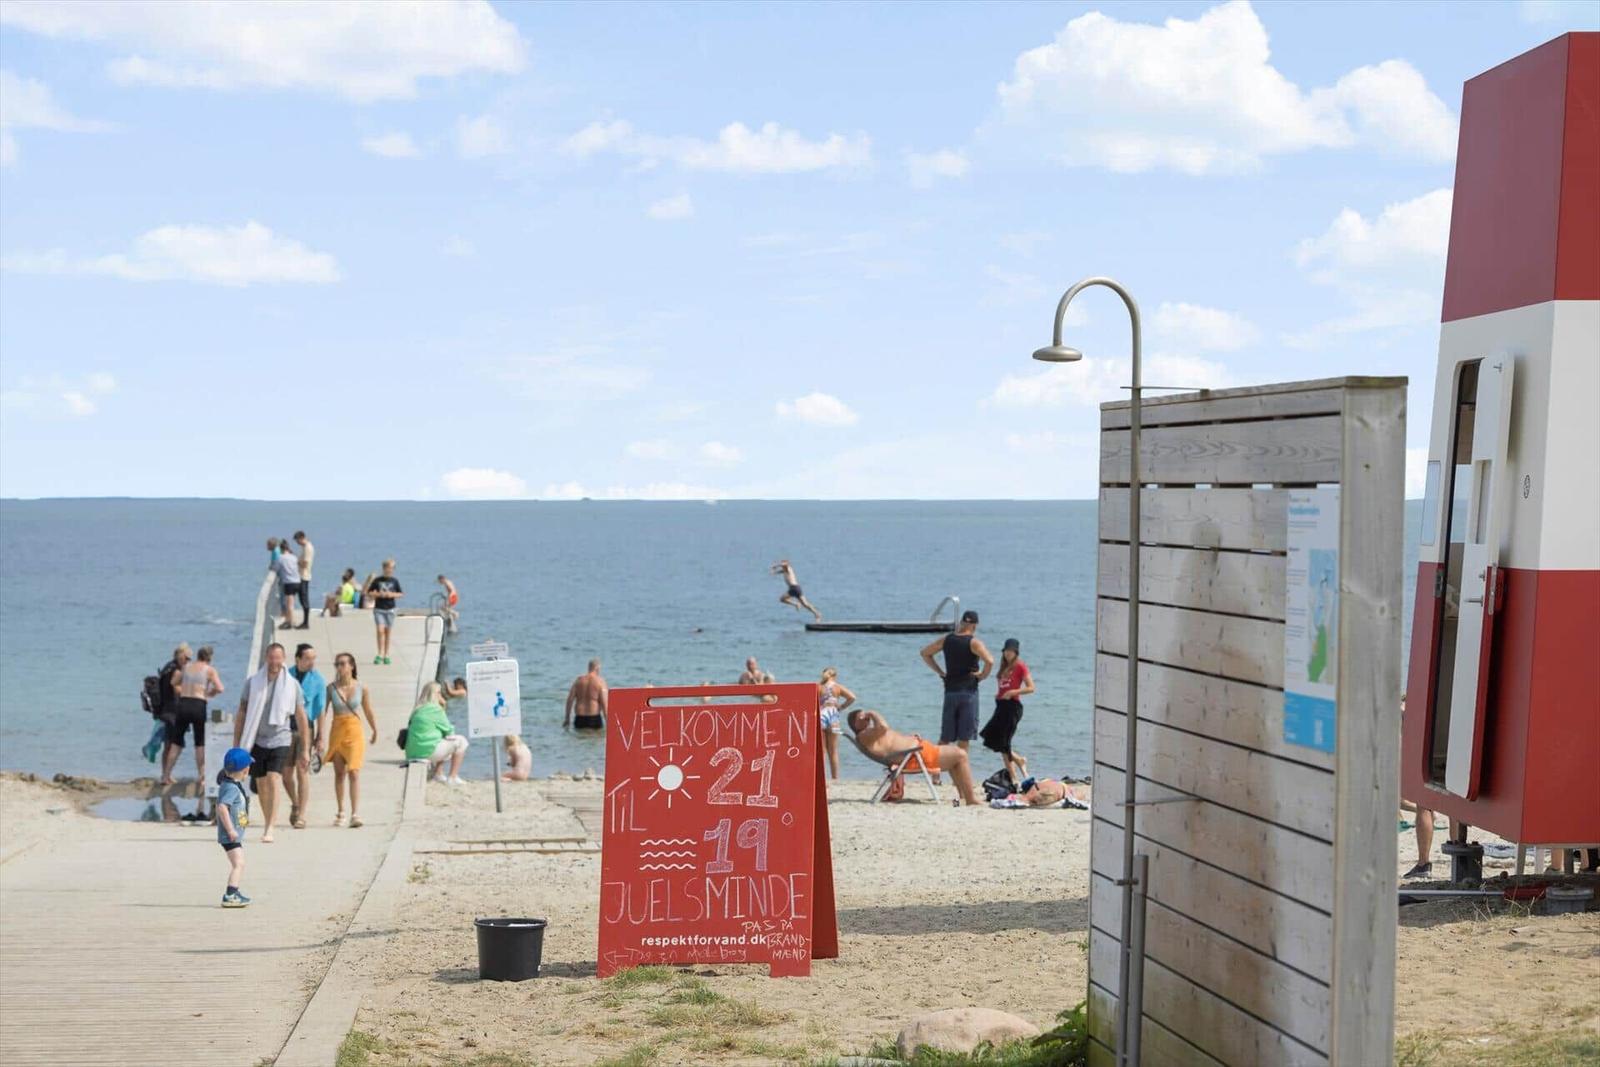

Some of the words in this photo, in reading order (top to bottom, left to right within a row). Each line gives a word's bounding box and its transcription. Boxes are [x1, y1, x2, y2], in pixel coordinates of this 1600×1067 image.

[615, 708, 808, 751] VELKOMMEN
[604, 873, 808, 925] JUELSMINDE
[741, 920, 776, 933] PAS
[641, 933, 767, 948] respektforvand.dk
[772, 948, 807, 961] MÆND
